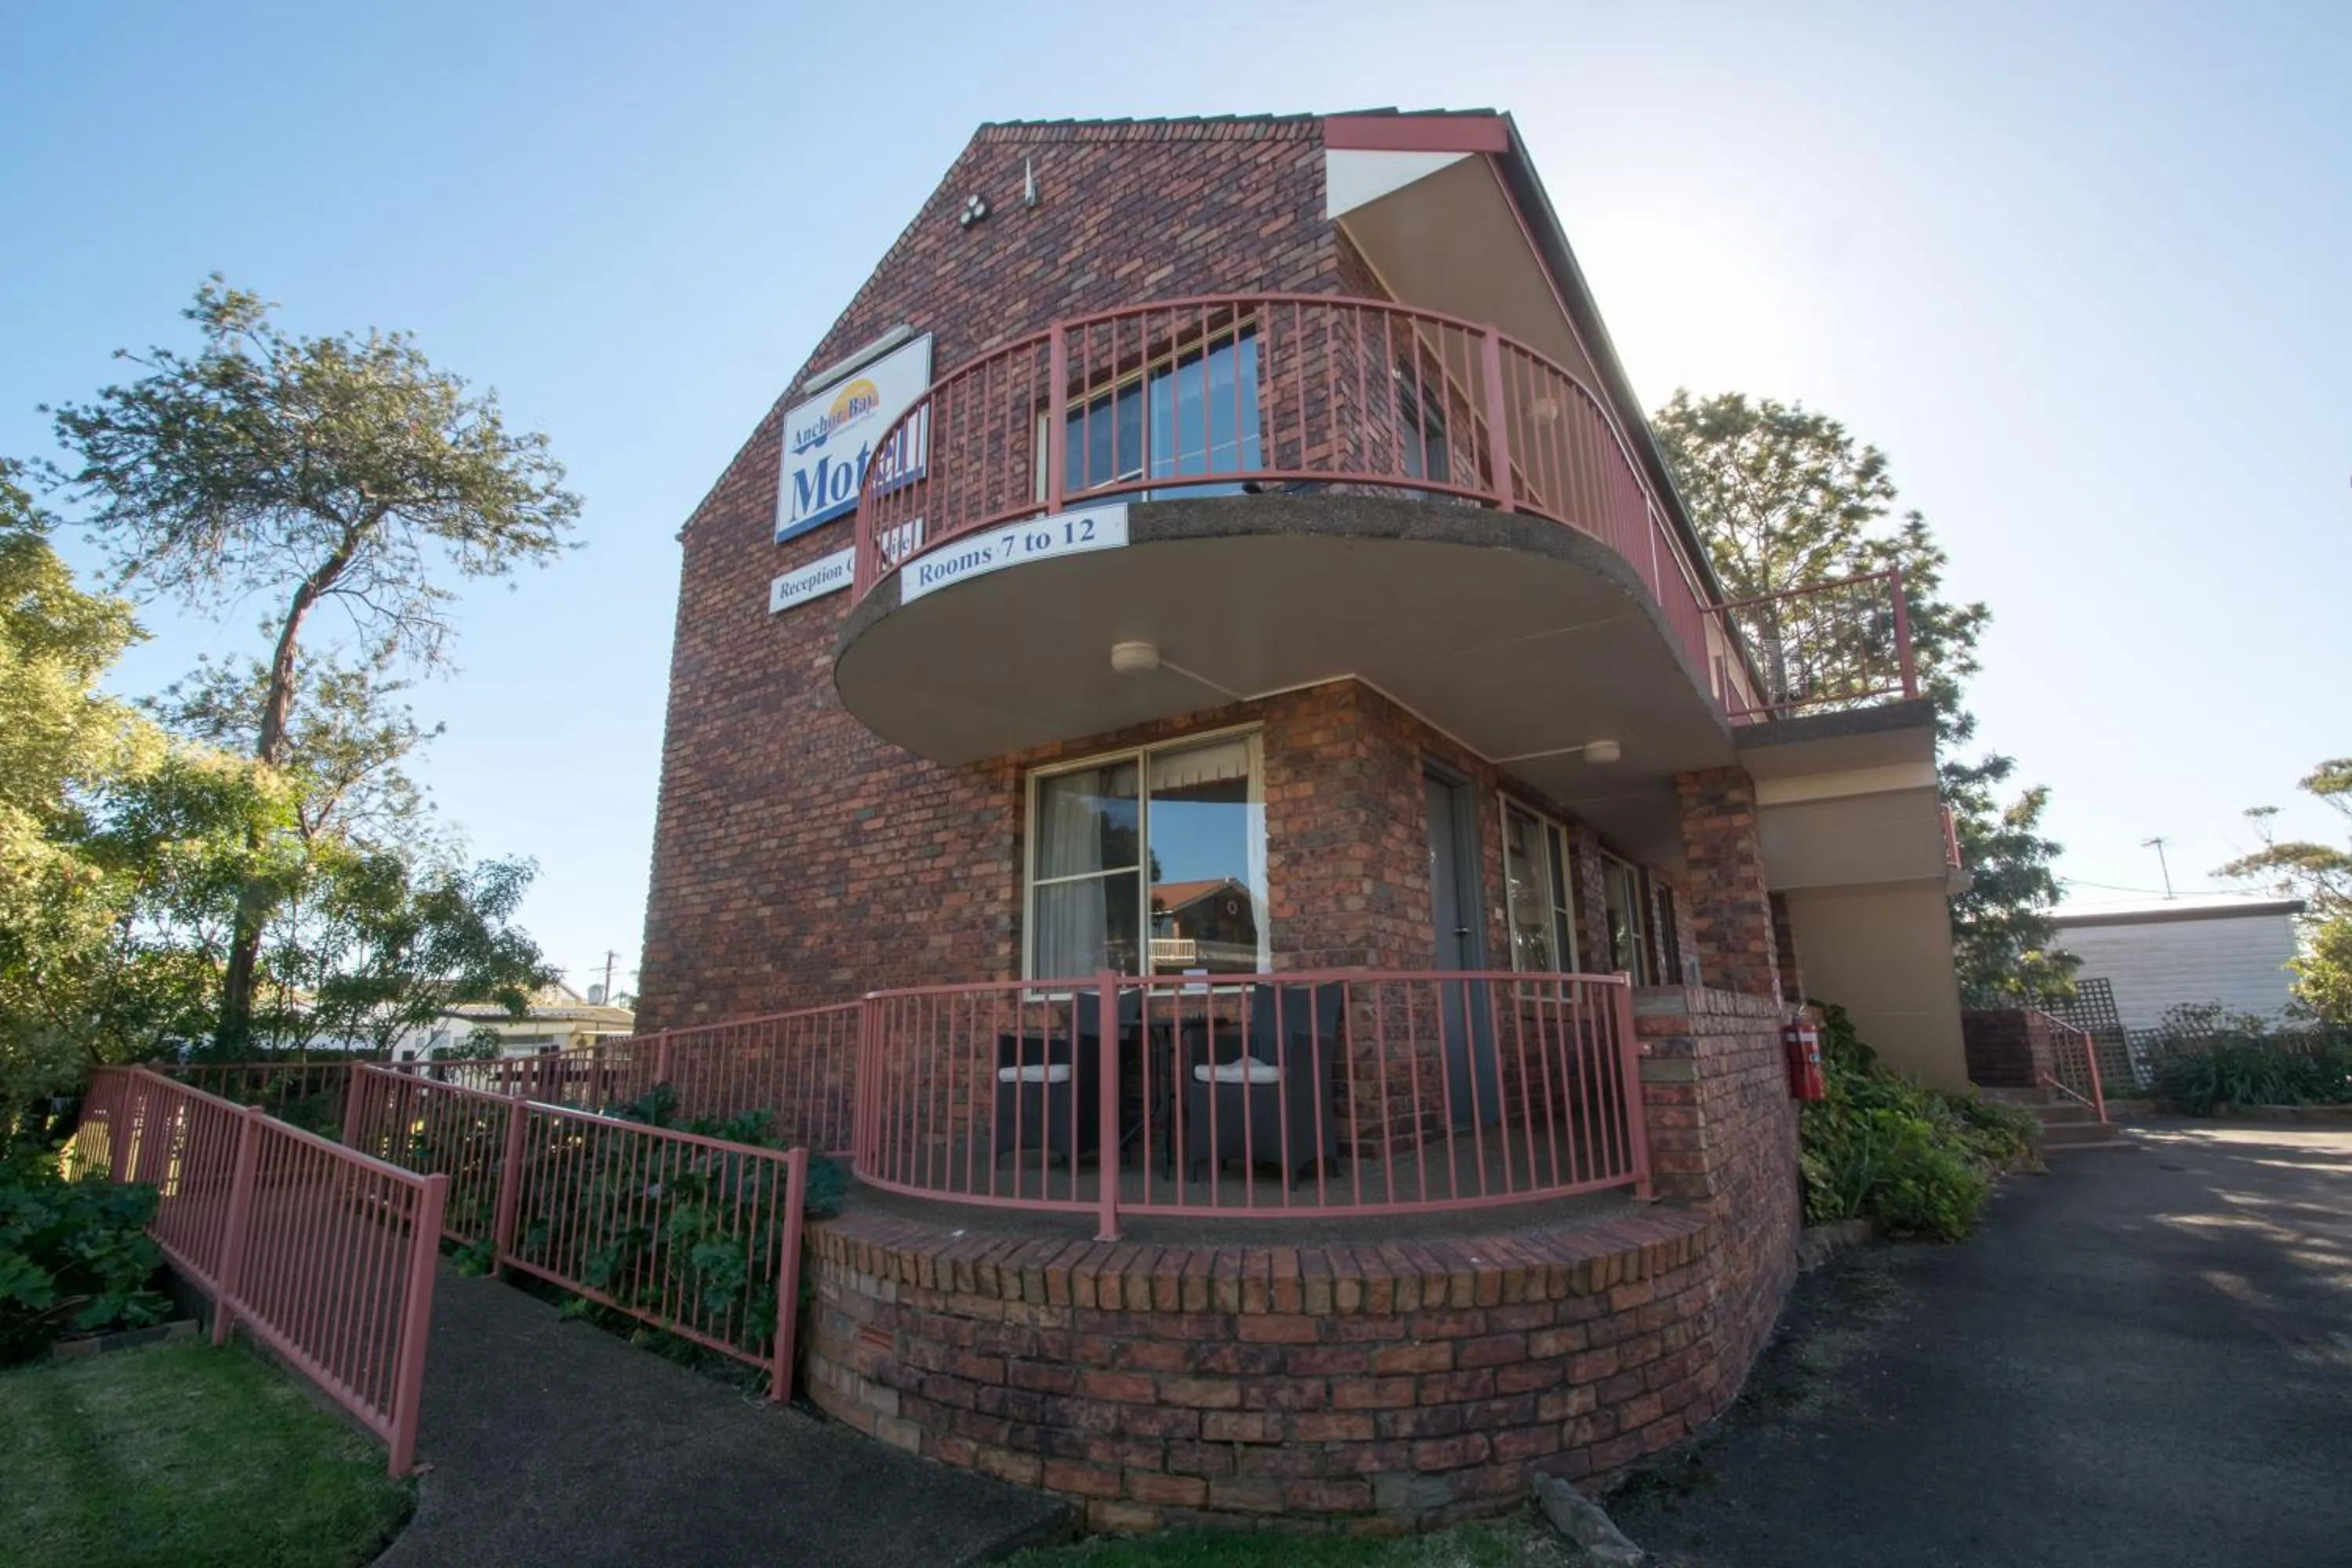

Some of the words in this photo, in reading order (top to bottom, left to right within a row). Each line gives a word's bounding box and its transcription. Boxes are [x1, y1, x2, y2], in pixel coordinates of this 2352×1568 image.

[794, 411, 842, 447] Anchor
[849, 394, 873, 417] Bay
[919, 546, 992, 587] Rooms
[1001, 535, 1015, 558] 7
[1025, 530, 1051, 552] to
[1063, 517, 1095, 544] 12
[779, 563, 844, 600] Reception
